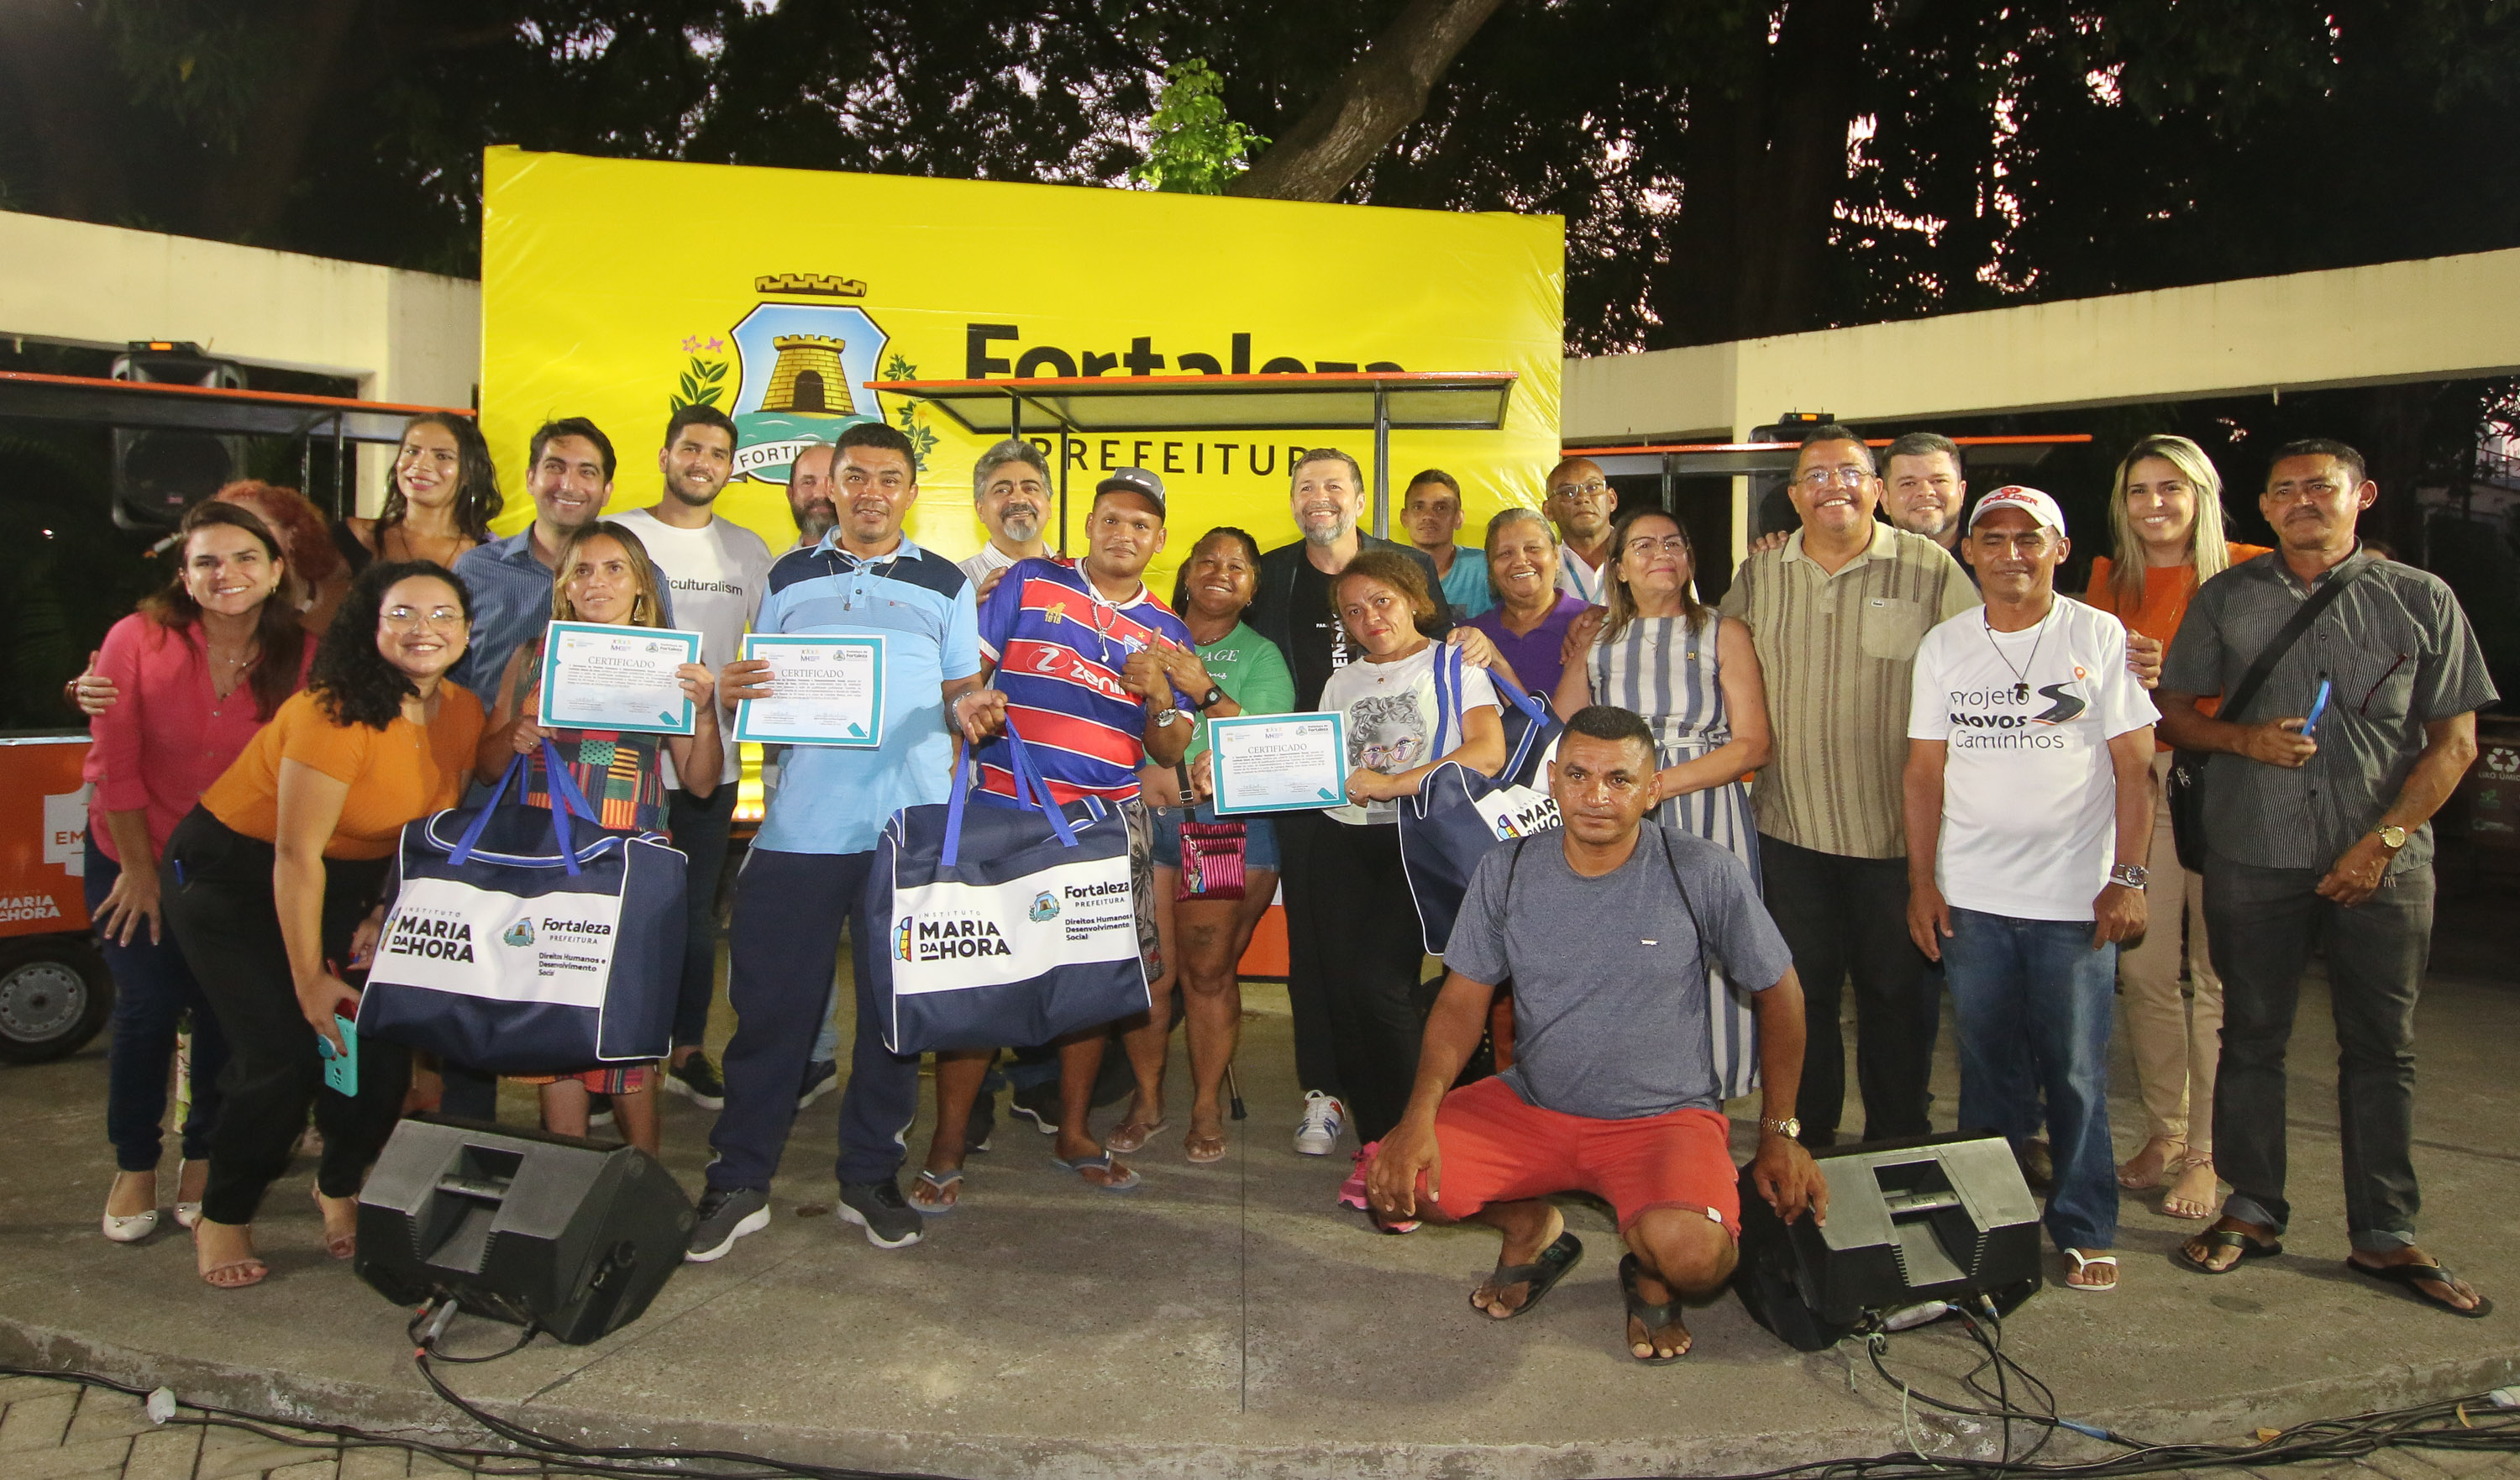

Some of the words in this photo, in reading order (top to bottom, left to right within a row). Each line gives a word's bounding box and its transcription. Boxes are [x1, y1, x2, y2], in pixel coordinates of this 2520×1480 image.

[738, 445, 808, 468] FORTI
[1029, 437, 1309, 477] PREFEITUR
[667, 576, 743, 596] iculturalism
[1045, 612, 1062, 624] 1918
[588, 656, 656, 669] CERTIFICADO
[1197, 649, 1239, 662] AGE
[781, 669, 844, 678] CERTIFICADO
[1950, 686, 2029, 710] Projeto
[1247, 743, 1308, 754] CERTIFICADO
[1956, 730, 2065, 749] Caminhos
[1516, 798, 1557, 827] MAR
[55, 831, 86, 845] EM
[1064, 881, 1130, 899] Fortaleza
[1075, 897, 1125, 907] PREFEITURA
[396, 915, 471, 942] MARIA
[542, 917, 612, 936] Fortaleza
[919, 920, 1001, 941] MARIA
[1066, 922, 1130, 933] Desenvolvimento
[549, 935, 598, 944] PREFEITURA
